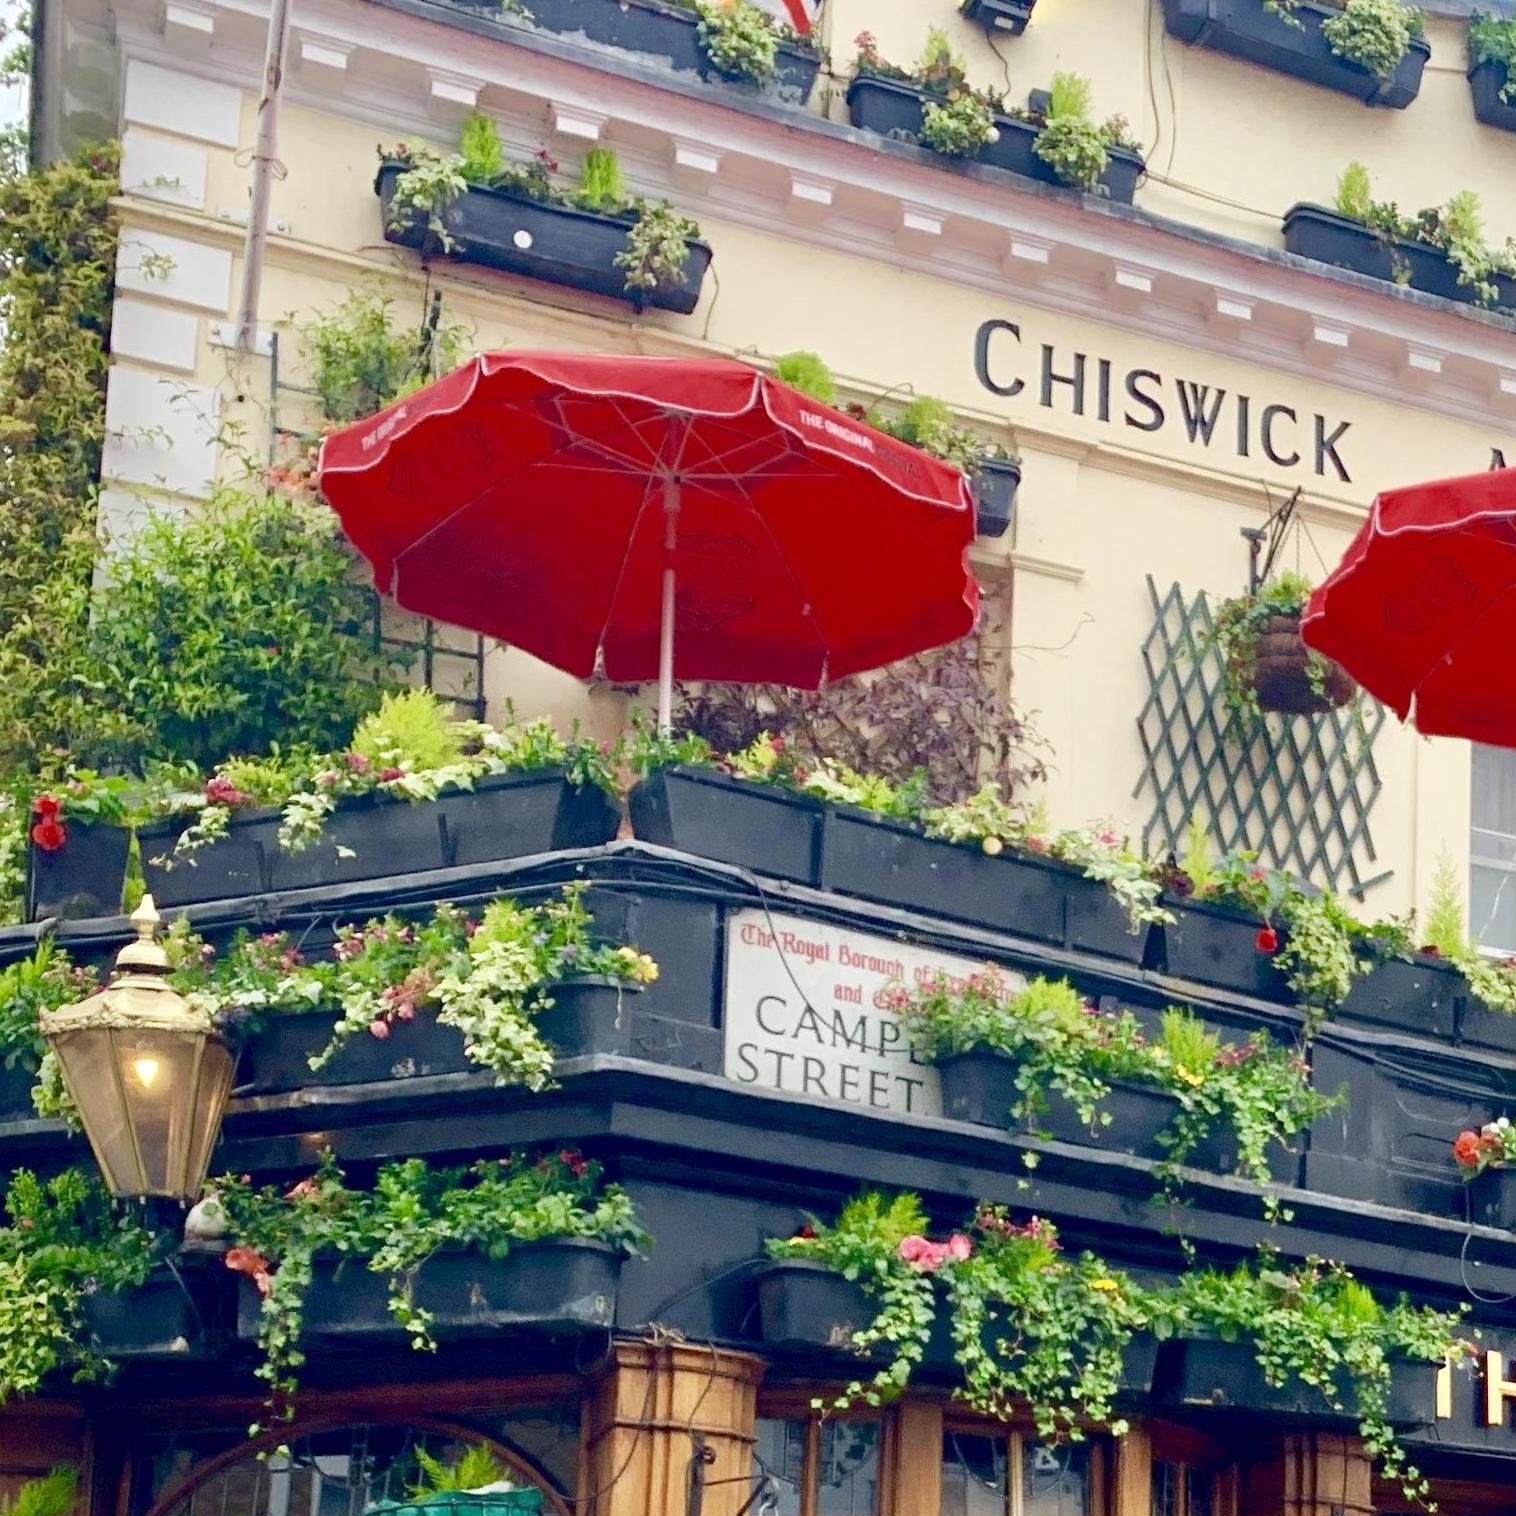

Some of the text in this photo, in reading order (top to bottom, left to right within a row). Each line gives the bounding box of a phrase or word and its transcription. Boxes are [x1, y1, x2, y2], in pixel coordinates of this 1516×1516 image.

[974, 319, 1353, 483] CHISWICK
[798, 409, 876, 453] THE ORIGINAL
[740, 923, 776, 949] The
[781, 931, 830, 965] Royal
[839, 945, 905, 978] Borough
[834, 981, 863, 1005] and
[737, 1043, 924, 1113] STREET
